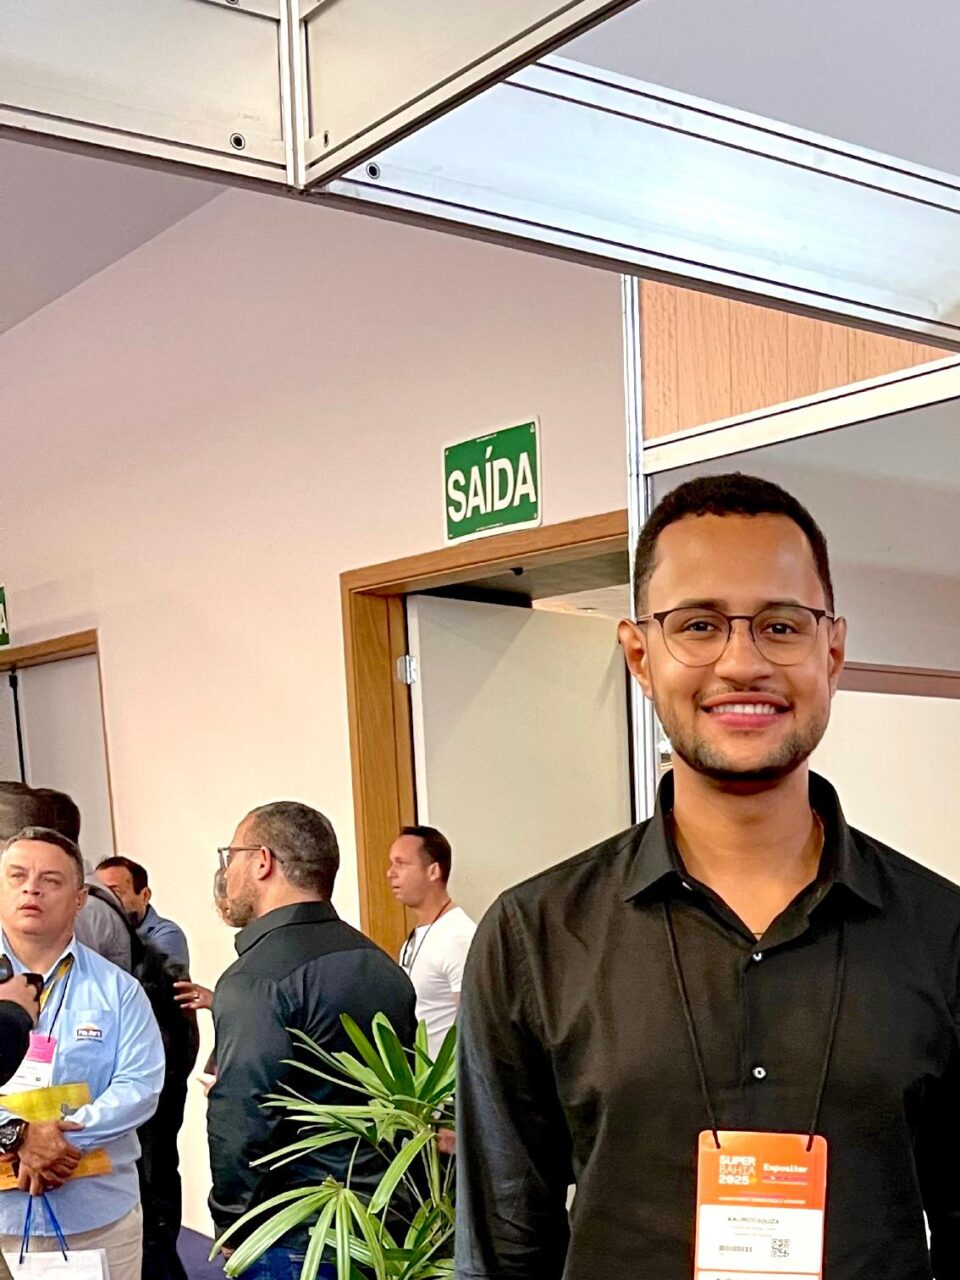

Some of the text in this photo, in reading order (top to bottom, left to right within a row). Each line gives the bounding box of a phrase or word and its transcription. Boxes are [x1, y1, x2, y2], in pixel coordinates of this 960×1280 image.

[447, 445, 537, 523] SAÍDA
[719, 1155, 756, 1166] SUPER
[719, 1165, 756, 1175] BAHIA
[718, 1174, 750, 1185] 2025
